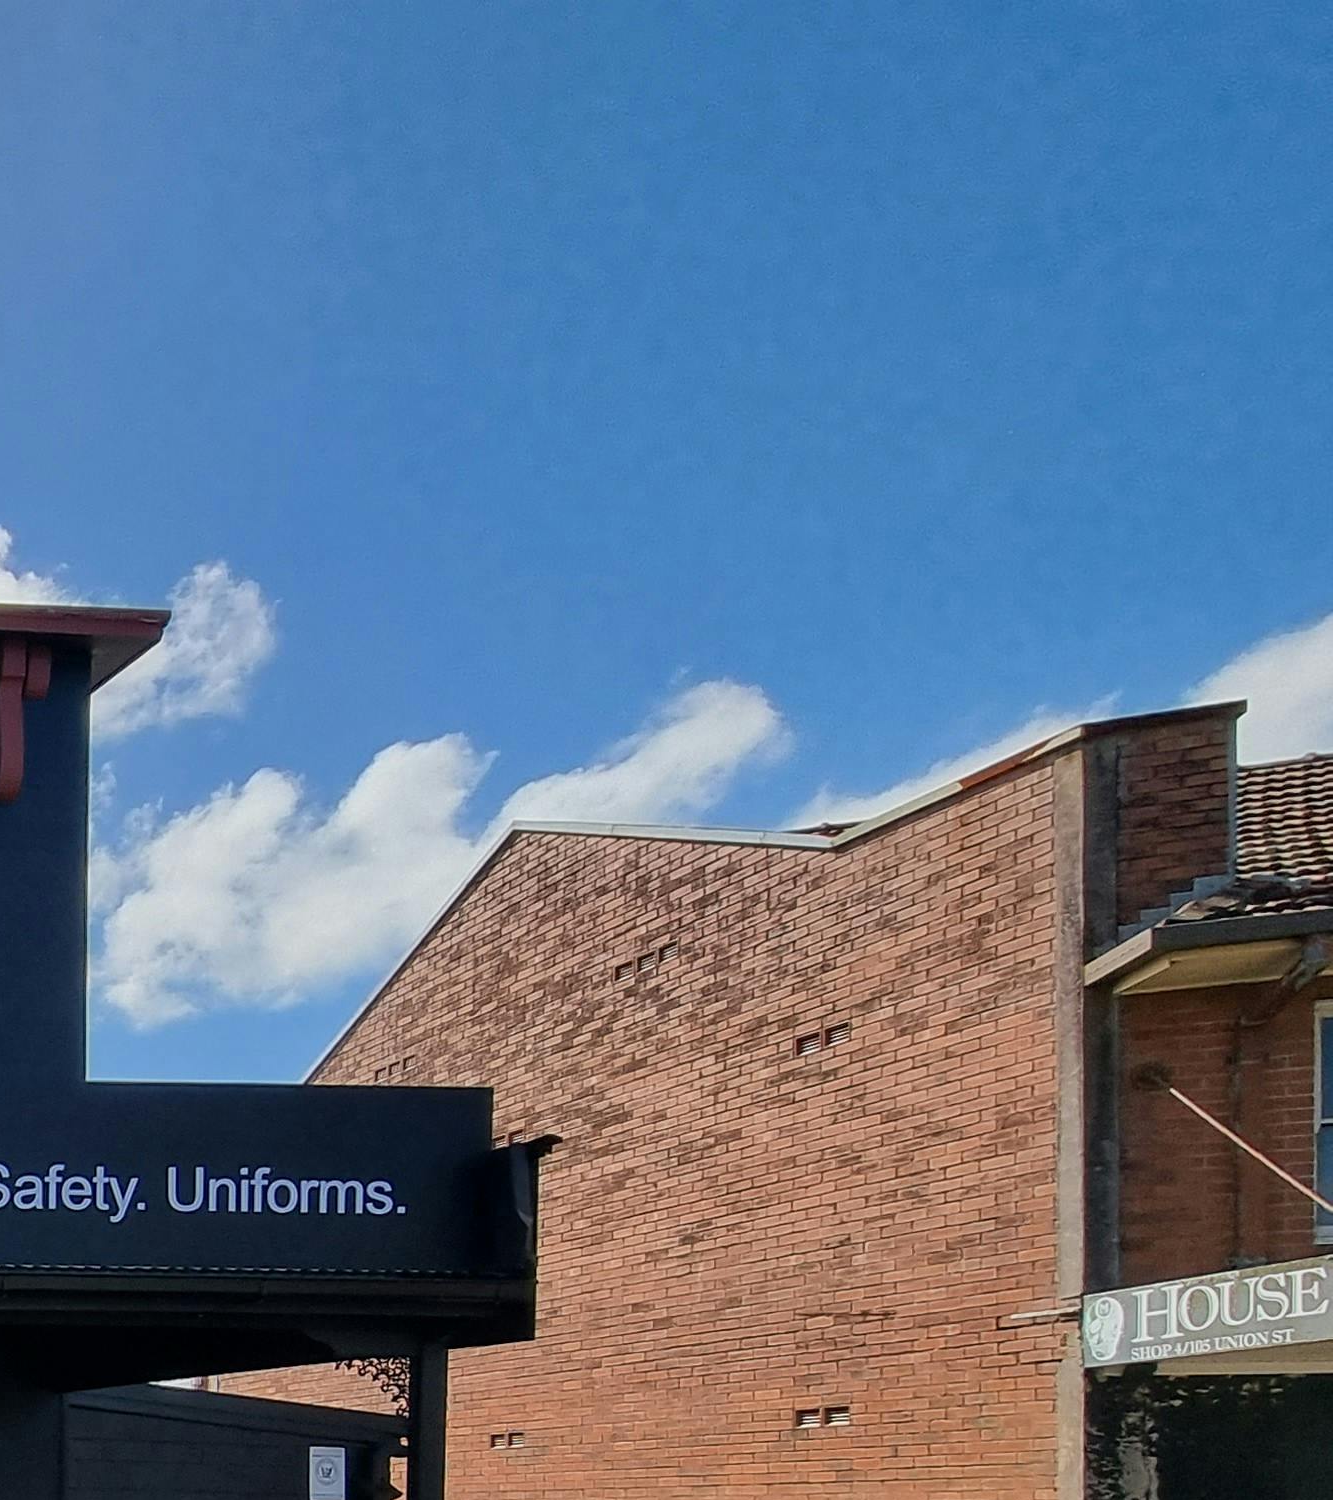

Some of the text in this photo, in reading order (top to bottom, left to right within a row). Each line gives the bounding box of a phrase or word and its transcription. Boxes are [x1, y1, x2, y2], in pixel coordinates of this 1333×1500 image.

[166, 1164, 407, 1215] Uniforms.
[1130, 1266, 1330, 1344] HOUSE
[1130, 1342, 1170, 1361] SHOP
[1214, 1330, 1269, 1350] UNION
[1271, 1328, 1295, 1344] ST
